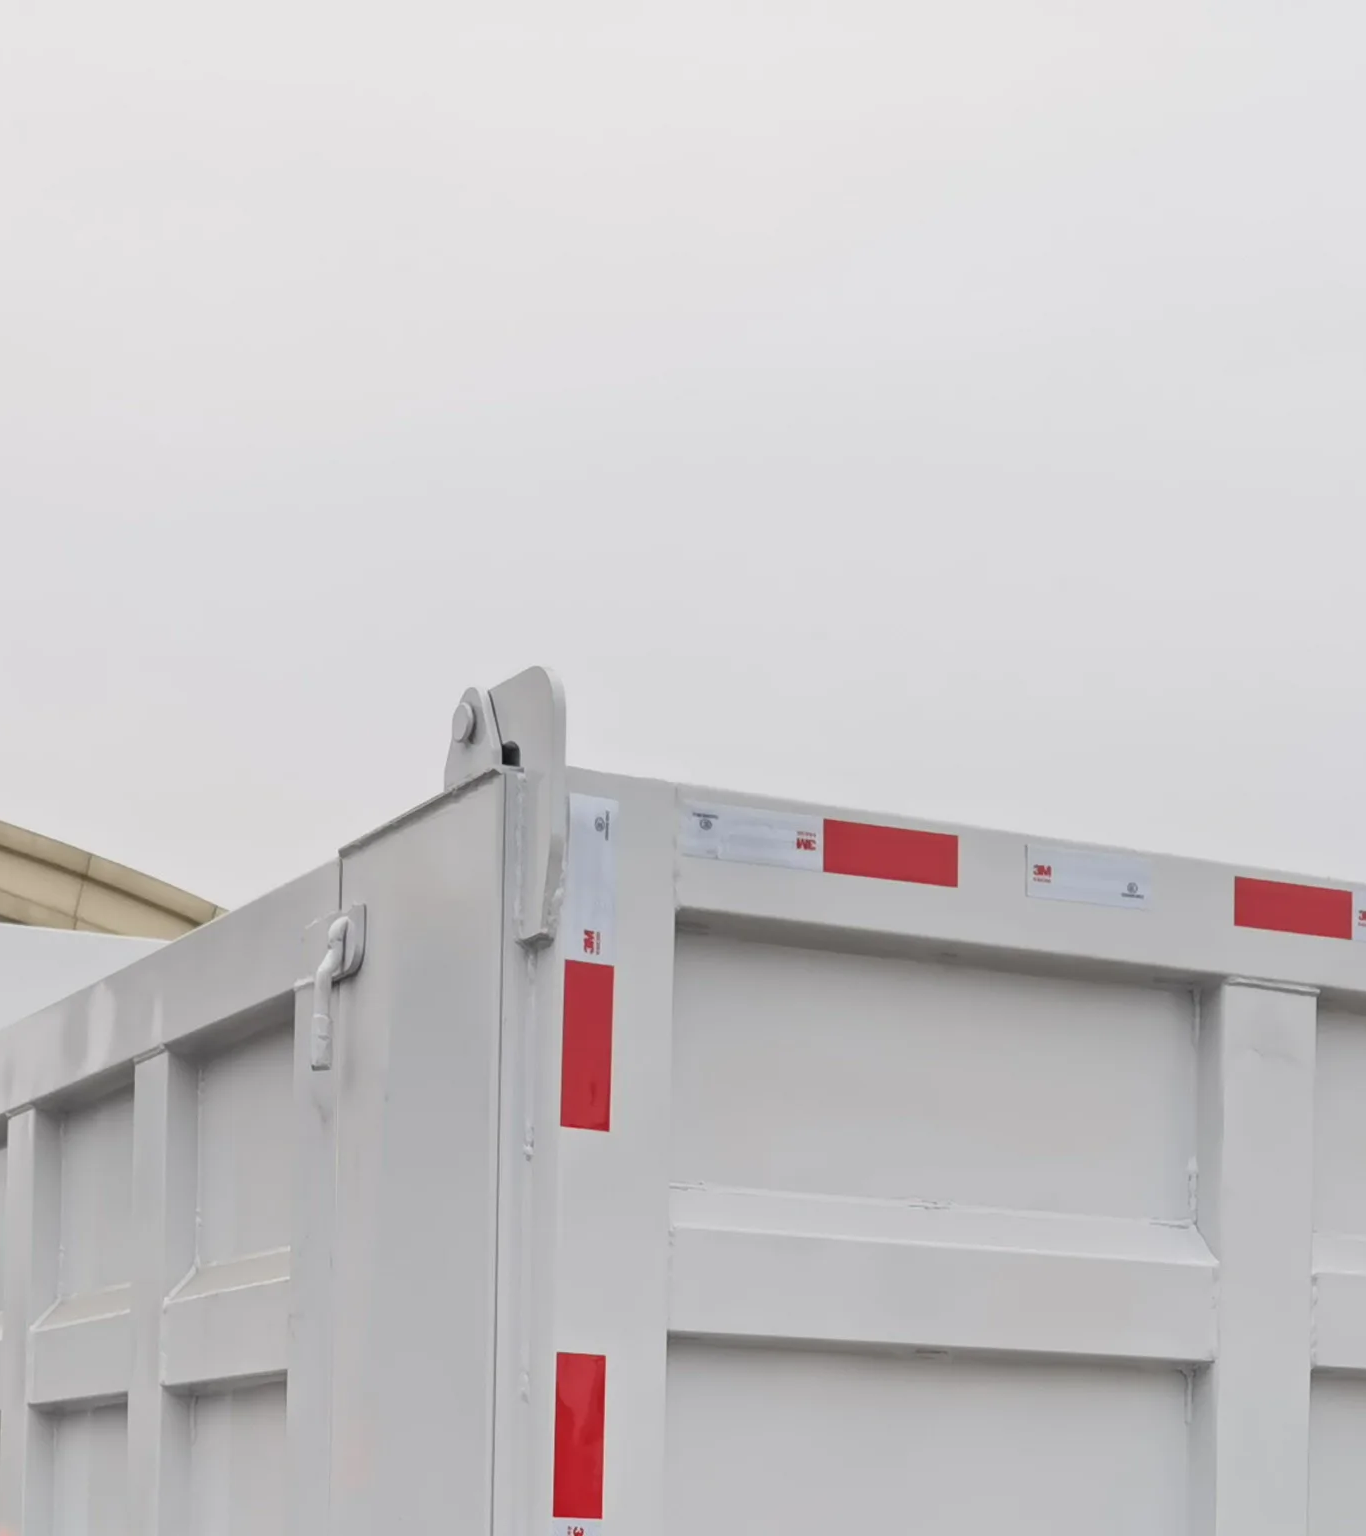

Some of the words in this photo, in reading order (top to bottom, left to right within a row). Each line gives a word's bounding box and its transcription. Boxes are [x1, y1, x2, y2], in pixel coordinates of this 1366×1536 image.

[795, 838, 817, 851] 3M
[1034, 865, 1053, 878] 3M
[583, 931, 596, 953] 3M
